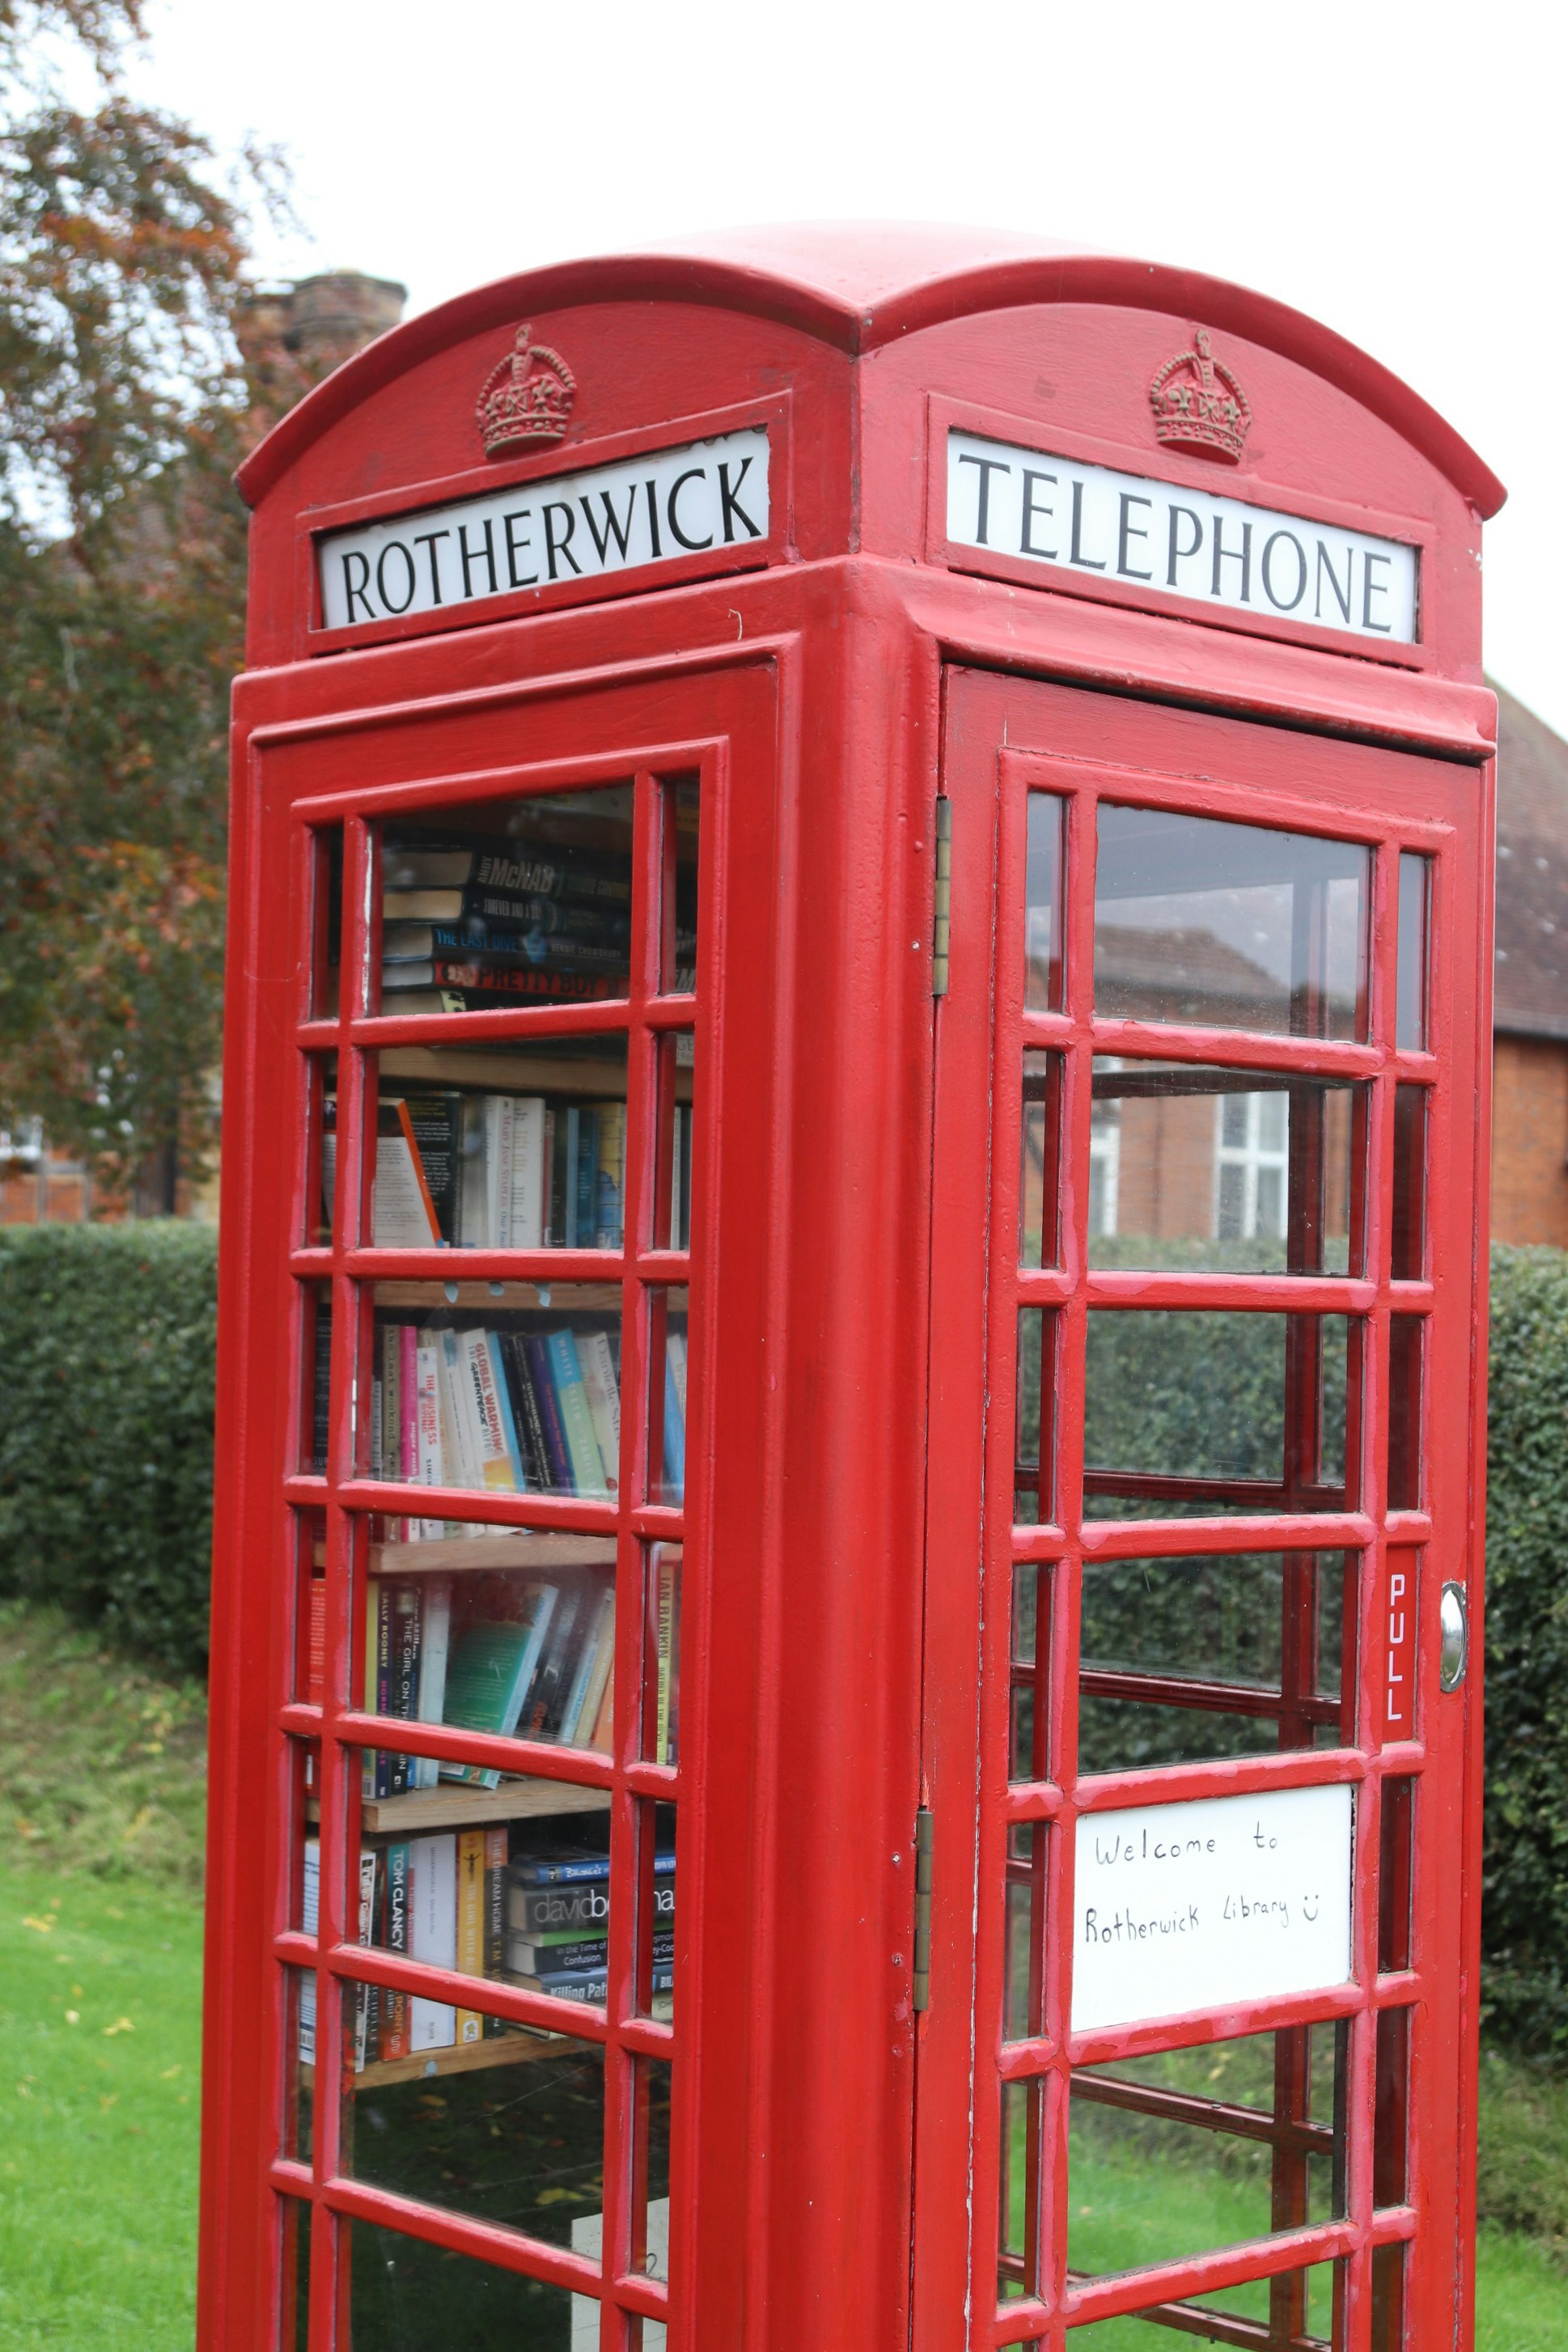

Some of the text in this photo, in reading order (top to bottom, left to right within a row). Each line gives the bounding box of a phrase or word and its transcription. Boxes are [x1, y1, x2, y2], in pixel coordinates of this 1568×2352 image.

[341, 456, 763, 623] ROTHERWICK
[958, 453, 1392, 634] TELEPHONE
[489, 856, 555, 893] McNAB
[434, 928, 519, 952] THE LAST DIVE
[478, 964, 600, 996] PRETTY BOY
[501, 1144, 511, 1167] JANE
[559, 1337, 572, 1377] WHITE
[426, 1374, 437, 1446] THE BUSINESS
[471, 1361, 488, 1427] GREENPEACE
[475, 1342, 504, 1456] GLOBAL WARMING
[381, 1591, 389, 1622] SALLY
[658, 1577, 672, 1659] IAN RANKIN
[381, 1625, 389, 1668] ROONEY
[403, 1618, 413, 1643] THE
[1388, 1574, 1405, 1721] PULL
[402, 1647, 412, 1676] GIRL
[400, 1680, 410, 1700] ON
[400, 1706, 409, 1718] TH
[492, 1837, 502, 1858] THE
[1095, 1820, 1278, 1865] Welcome to
[467, 1884, 477, 1901] THE
[491, 1861, 502, 1902] DREAM
[391, 1850, 405, 1948] TOM CLANCY
[466, 1903, 477, 1925] GIRL
[491, 1903, 502, 1935] HOME
[1085, 1894, 1290, 1943] Rotherwick Library
[466, 1928, 477, 1953] WITH
[580, 1942, 598, 1953] Time
[598, 1940, 608, 1949] of
[563, 1952, 602, 1966] Confusion
[550, 1981, 584, 2001] Killing
[369, 1985, 379, 2044] ICHELLE
[393, 1995, 405, 2034] POINT
